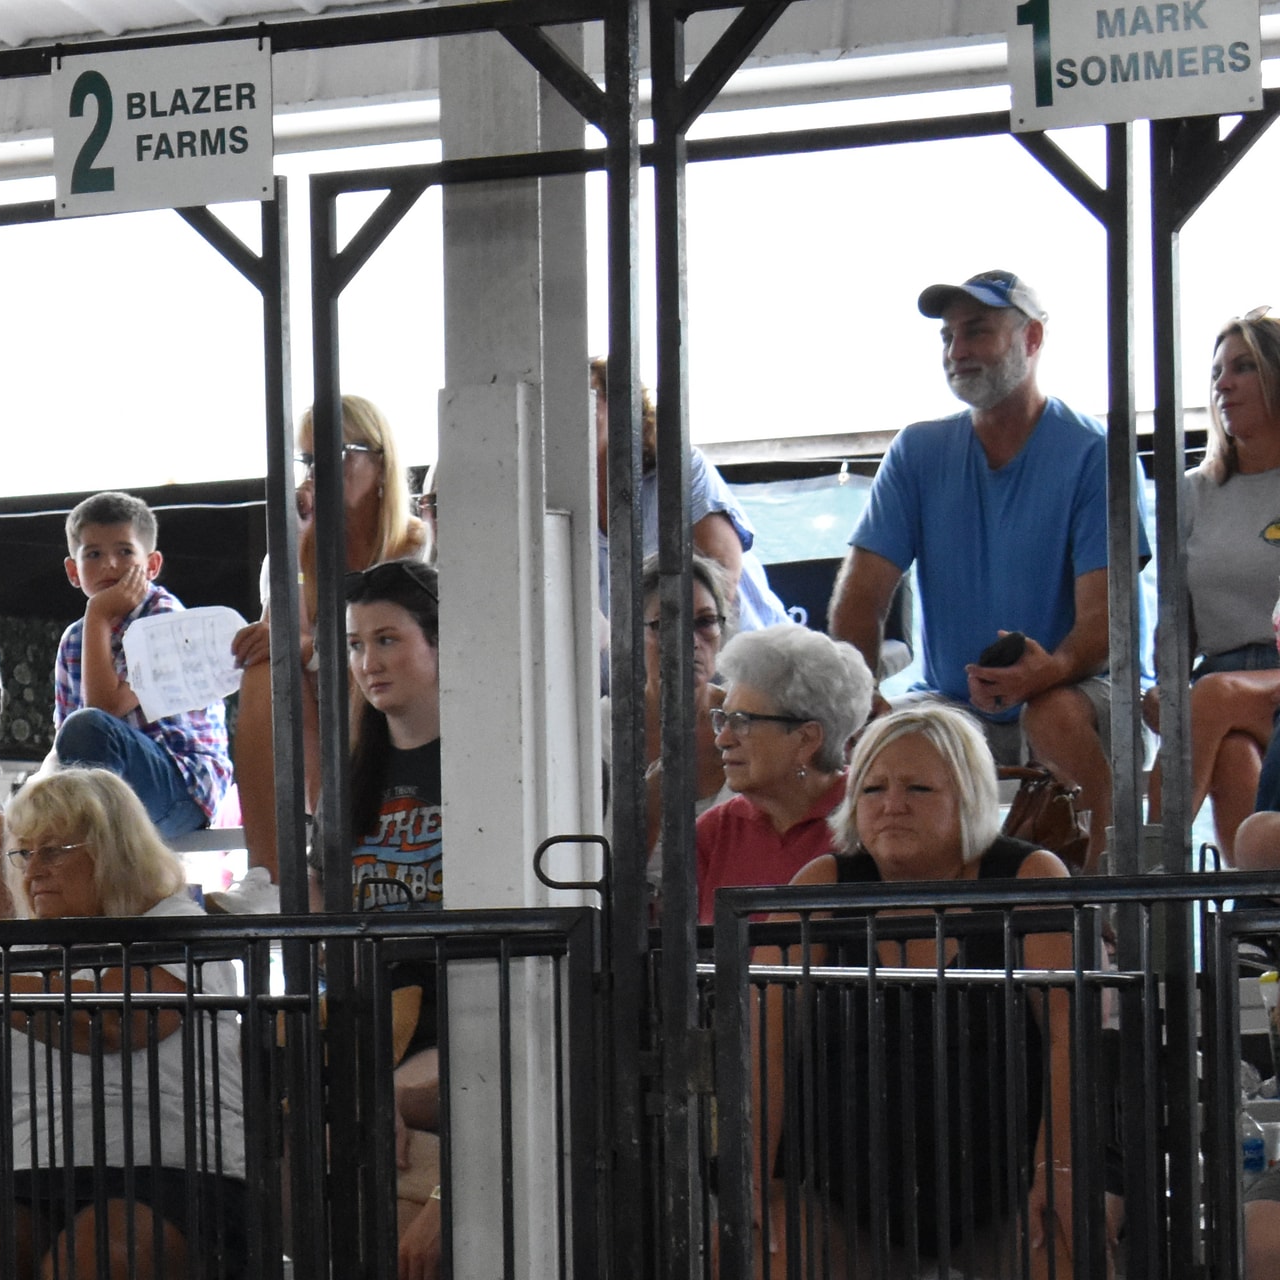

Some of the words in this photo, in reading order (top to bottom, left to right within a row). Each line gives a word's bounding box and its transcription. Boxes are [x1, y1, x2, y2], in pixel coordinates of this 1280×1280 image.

[1096, 0, 1208, 39] MARK
[1016, 0, 1053, 107] 1
[1055, 41, 1251, 89] SOMMERS
[126, 82, 256, 120] BLAZER
[69, 70, 115, 194] 2
[136, 125, 249, 161] FARMS
